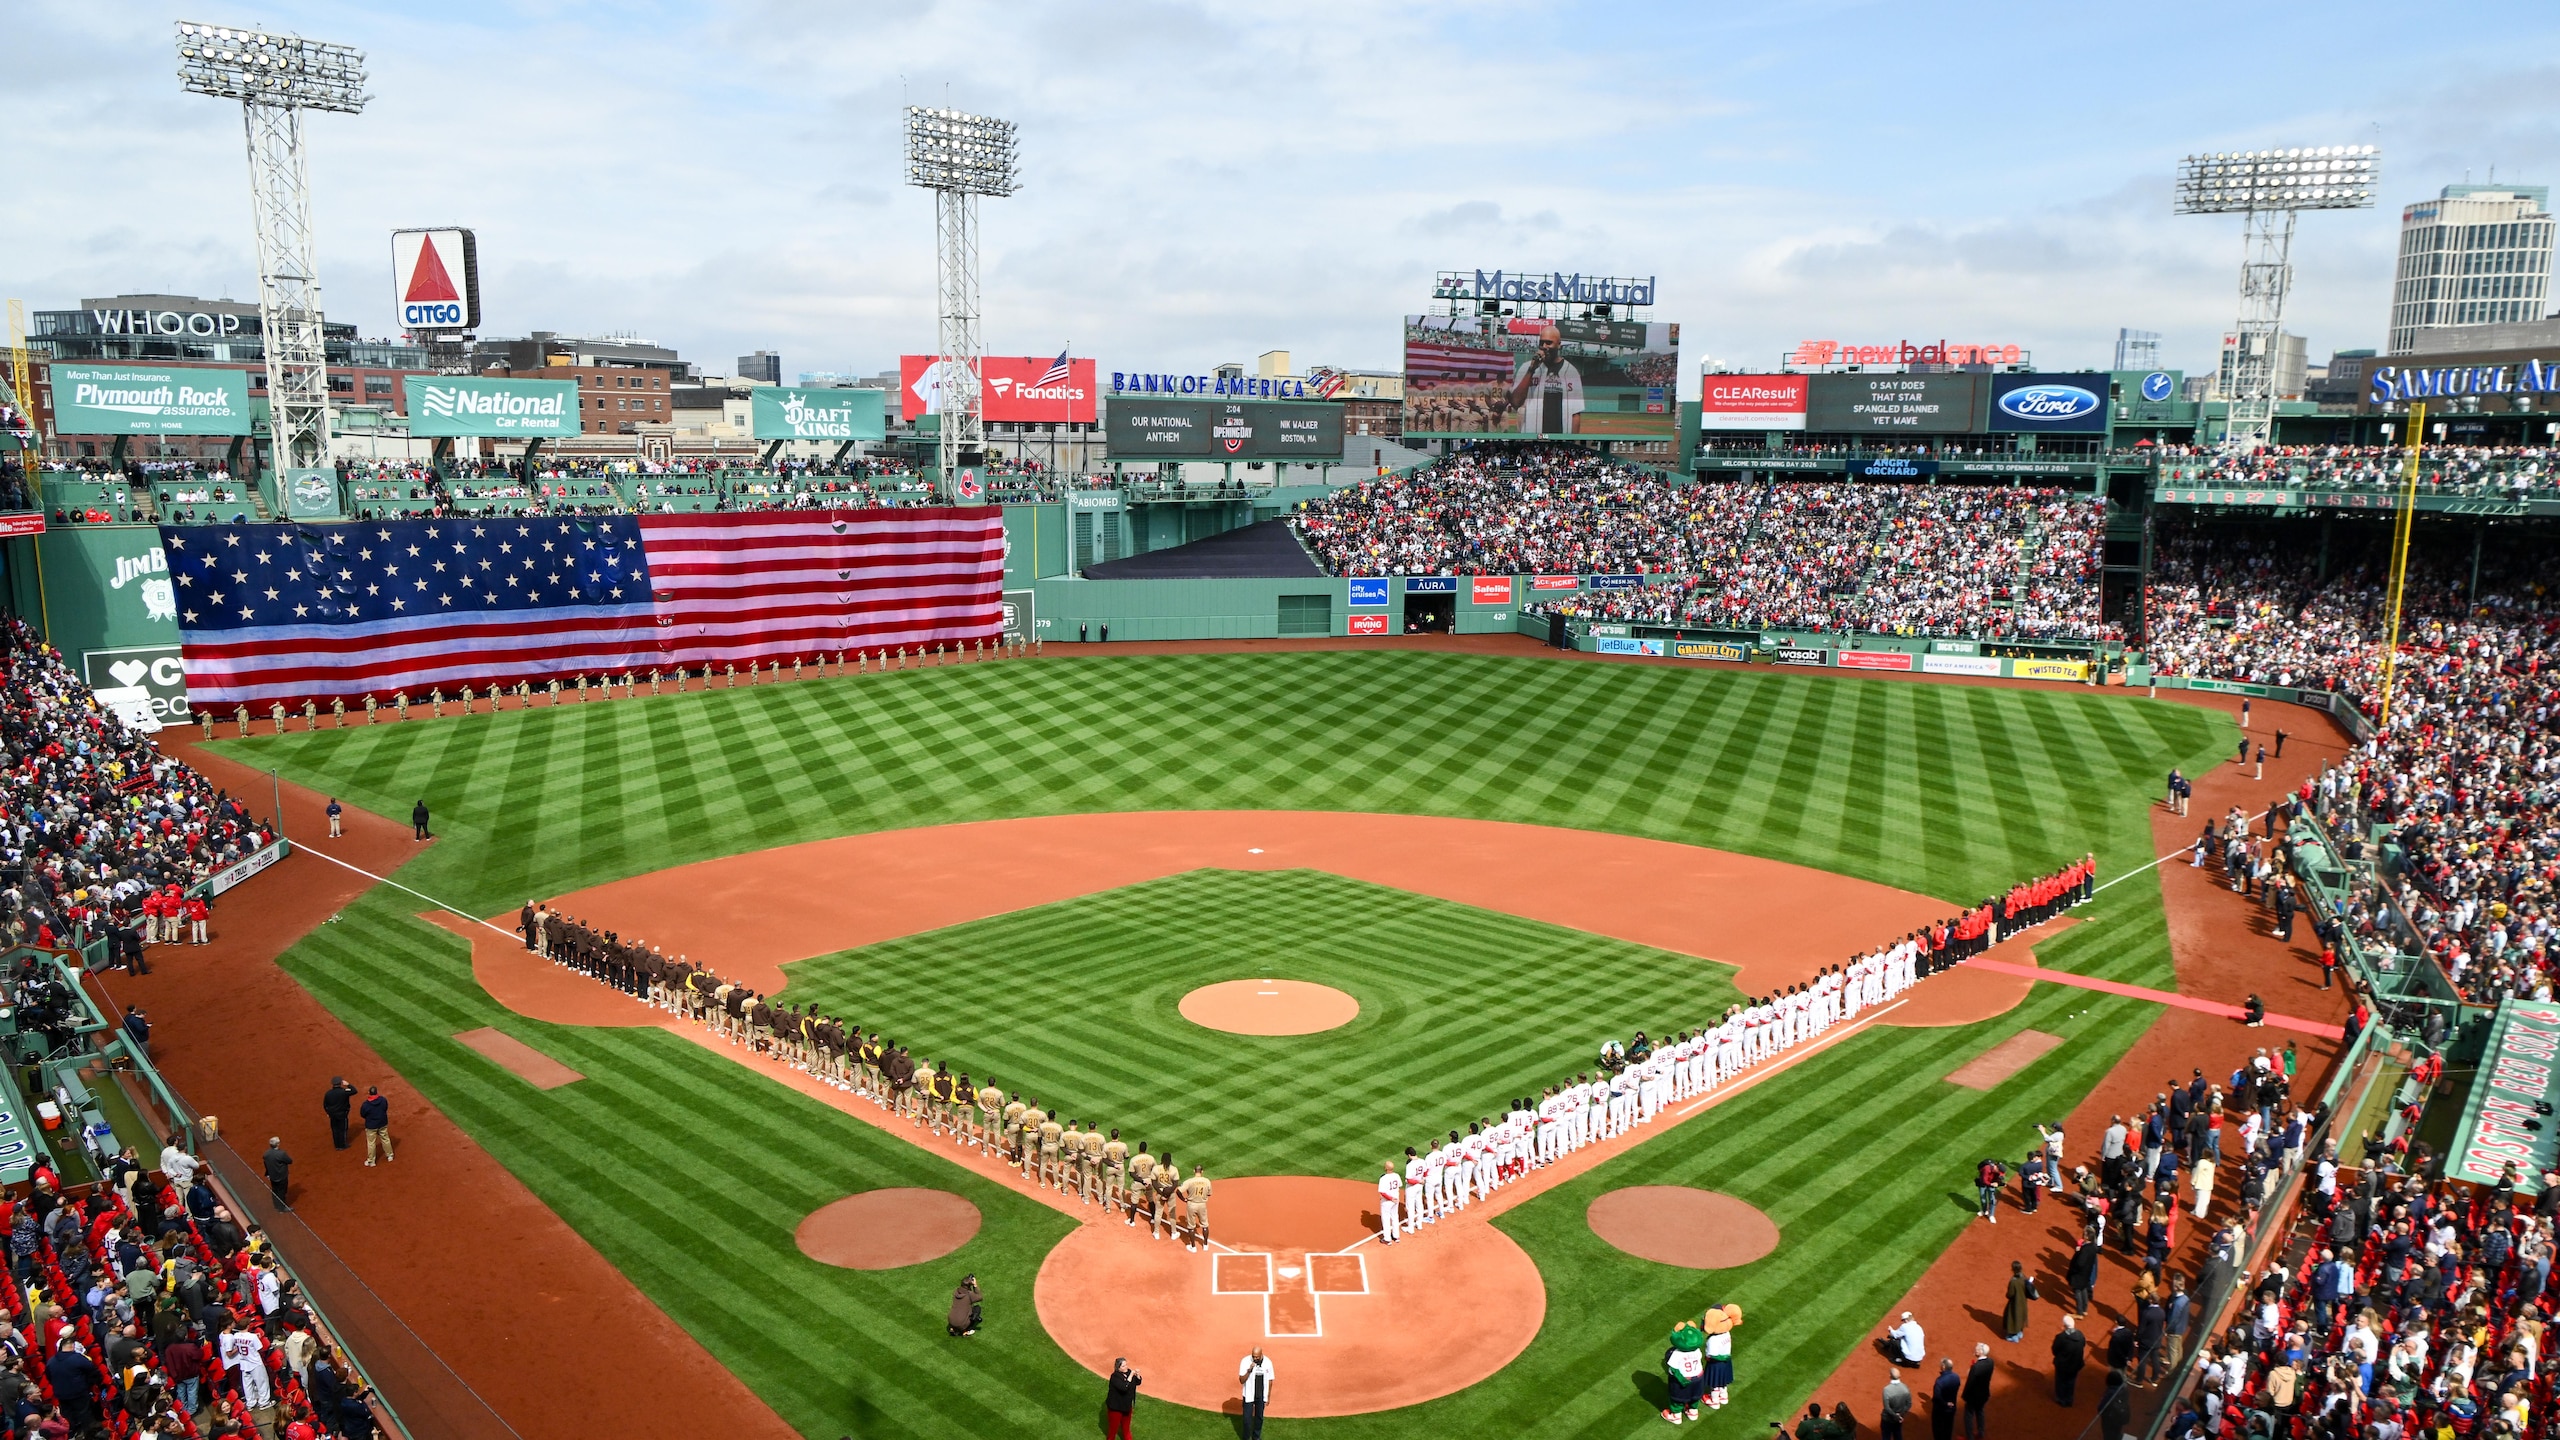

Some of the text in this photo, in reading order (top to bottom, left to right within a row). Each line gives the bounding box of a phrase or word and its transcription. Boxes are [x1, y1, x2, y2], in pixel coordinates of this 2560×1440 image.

[1475, 269, 1655, 305] MassMutual
[405, 304, 461, 324] CITGO
[93, 309, 240, 337] WHOOP
[1841, 339, 2021, 365] new balance
[67, 371, 172, 382] More Than Just Insurance.
[1112, 372, 1305, 398] BANK OF AMERICA
[1870, 382, 1925, 390] O SAY DOES
[2369, 366, 2512, 405] SAMUEL
[76, 384, 229, 407] Plymouth Rock
[1016, 383, 1084, 400] Fanatics
[1713, 387, 1797, 399] CLEAResult
[1872, 393, 1922, 402] THAT STAR
[2018, 389, 2078, 415] Ford
[1853, 405, 1939, 413] SPANGLED BANNER
[785, 406, 852, 424] DRAFT
[1873, 416, 1918, 425] YET WAVE
[496, 417, 559, 428] Car Rental
[1131, 416, 1193, 428] OUR NATIONAL
[1292, 420, 1318, 430] WALKER
[794, 421, 851, 437] KINGS
[1213, 426, 1253, 439] OPENING DAY
[1145, 432, 1180, 442] ANTHEM
[1281, 434, 1317, 444] BOSTON, MA
[1760, 460, 1785, 468] OPENING
[1873, 459, 1911, 467] ANGRY
[2005, 464, 2033, 472] OPENING
[1865, 466, 1918, 476] ORCHARD
[1078, 498, 1119, 507] ABIOMED
[2165, 491, 2176, 503] 9
[2186, 491, 2196, 503] 4
[2206, 491, 2214, 503] 1
[2245, 492, 2264, 504] 27
[2326, 494, 2342, 506] 45
[110, 554, 152, 590] JIM
[1551, 578, 1577, 588] TICKET
[1351, 590, 1377, 598] cruises
[1474, 585, 1510, 593] Safelite
[1493, 613, 1507, 621] 420
[1354, 620, 1382, 629] IRVING
[1601, 639, 1635, 651] jetBlue
[1677, 643, 1719, 656] GRANITE
[1720, 645, 1742, 659] CITY
[1779, 650, 1820, 660] wasabi
[2029, 665, 2078, 678] TWISTED TEA
[2463, 1021, 2560, 1184] BOSTON RED SOX
[1471, 1141, 1483, 1151] 40
[1451, 1148, 1462, 1158] 16
[1434, 1156, 1444, 1167] 10
[1415, 1166, 1424, 1176] 19
[1389, 1180, 1399, 1191] 13
[1195, 1187, 1204, 1196] 14
[1684, 1360, 1699, 1373] 97
